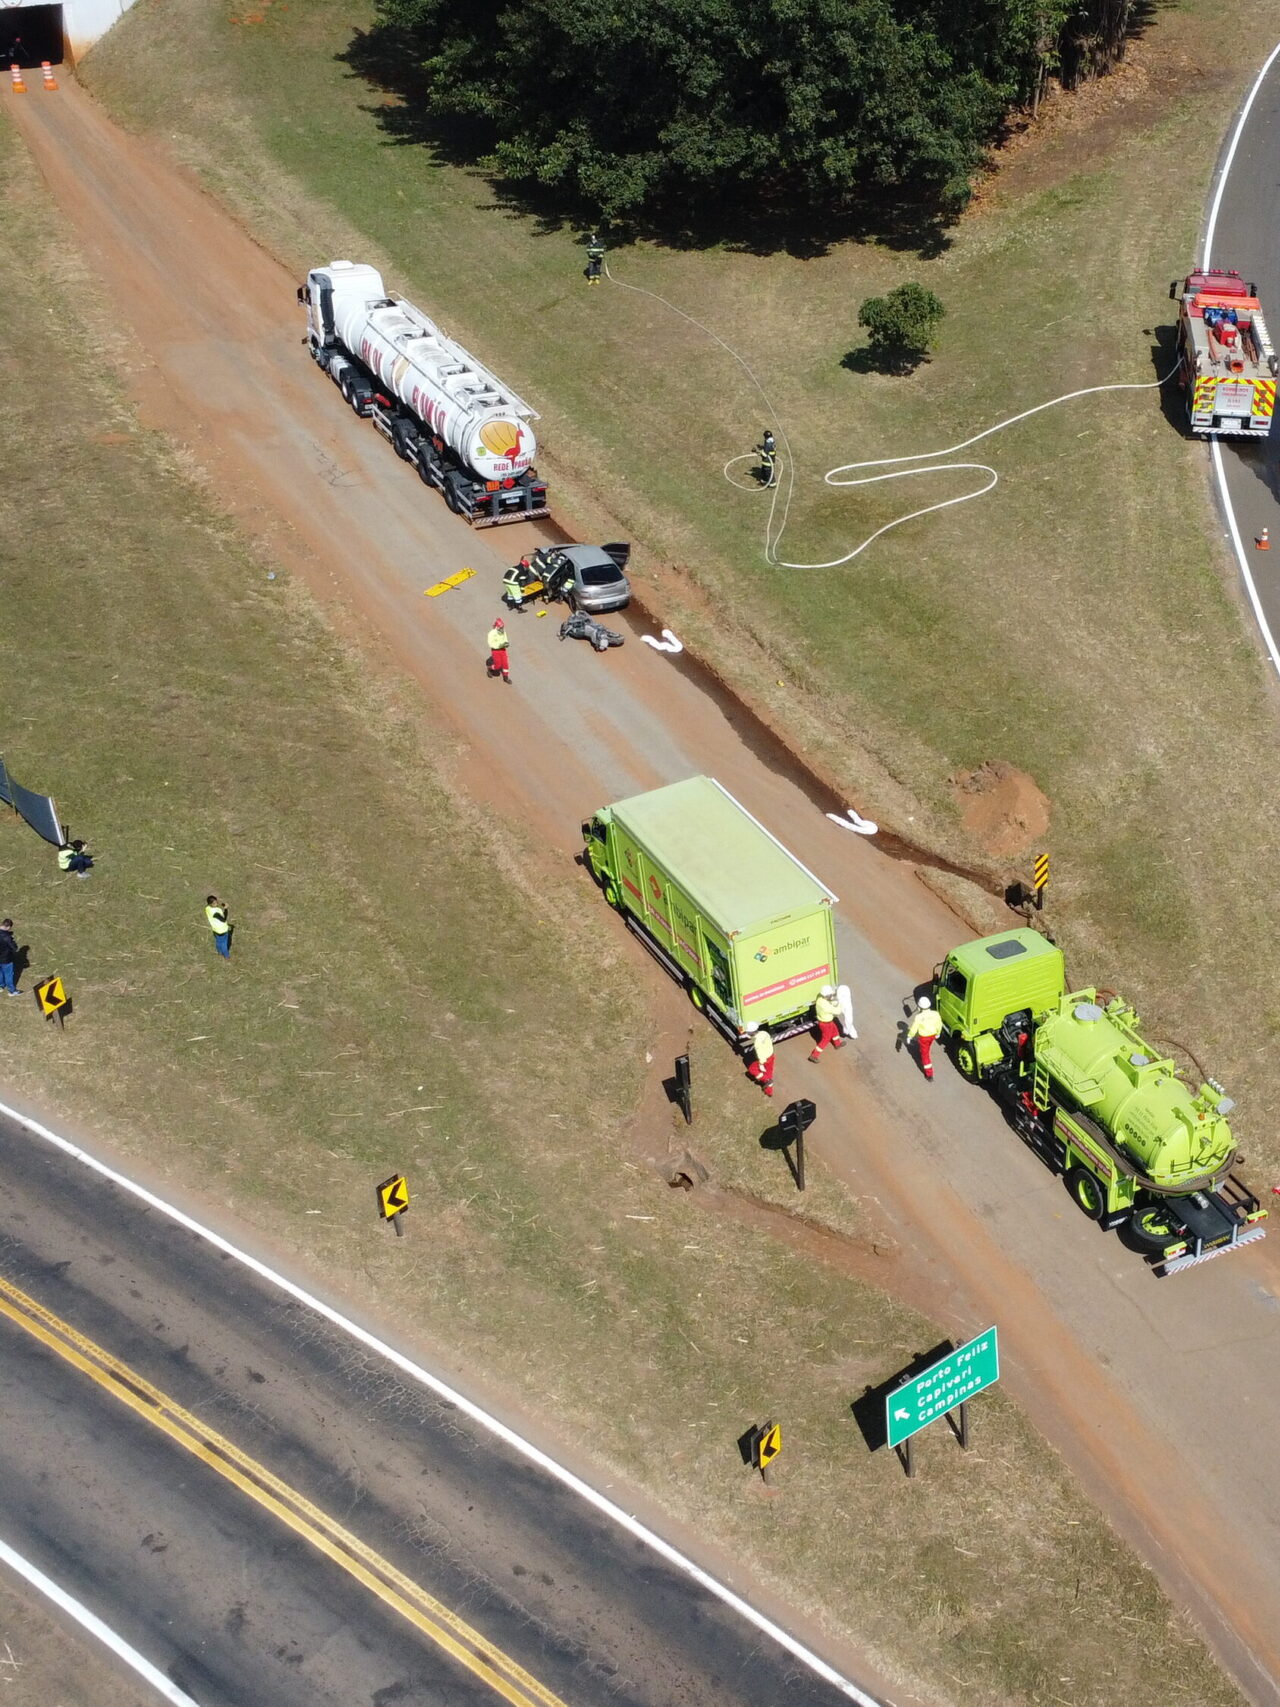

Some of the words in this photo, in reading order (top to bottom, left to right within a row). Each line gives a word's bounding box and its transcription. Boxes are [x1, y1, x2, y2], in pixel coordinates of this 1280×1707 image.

[773, 936, 811, 955] ambipar
[916, 1366, 952, 1393] Porto
[956, 1341, 989, 1367] Feliz
[917, 1365, 972, 1407] Capivari
[918, 1376, 982, 1421] Campinas
